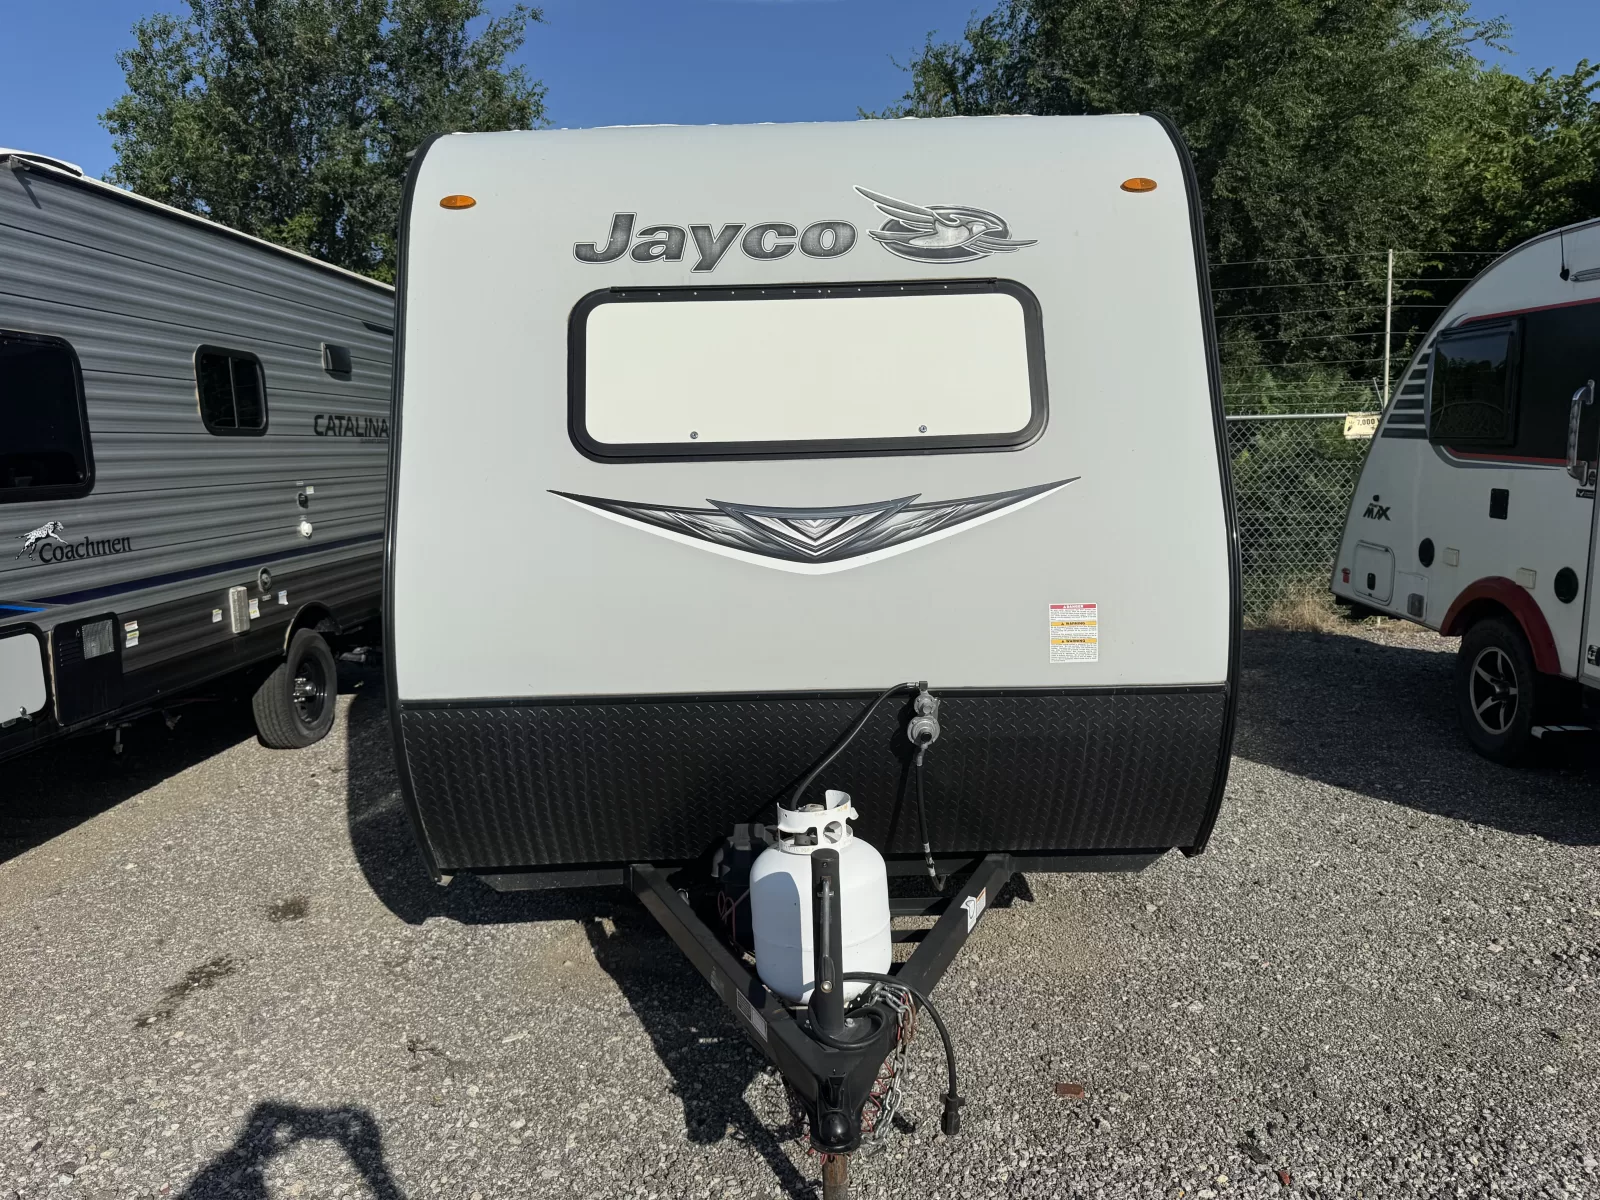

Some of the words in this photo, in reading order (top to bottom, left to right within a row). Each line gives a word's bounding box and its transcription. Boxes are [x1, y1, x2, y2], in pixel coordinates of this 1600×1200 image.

[573, 212, 858, 273] Jayco
[314, 415, 389, 437] CATALINA
[39, 536, 132, 563] Coachmen
